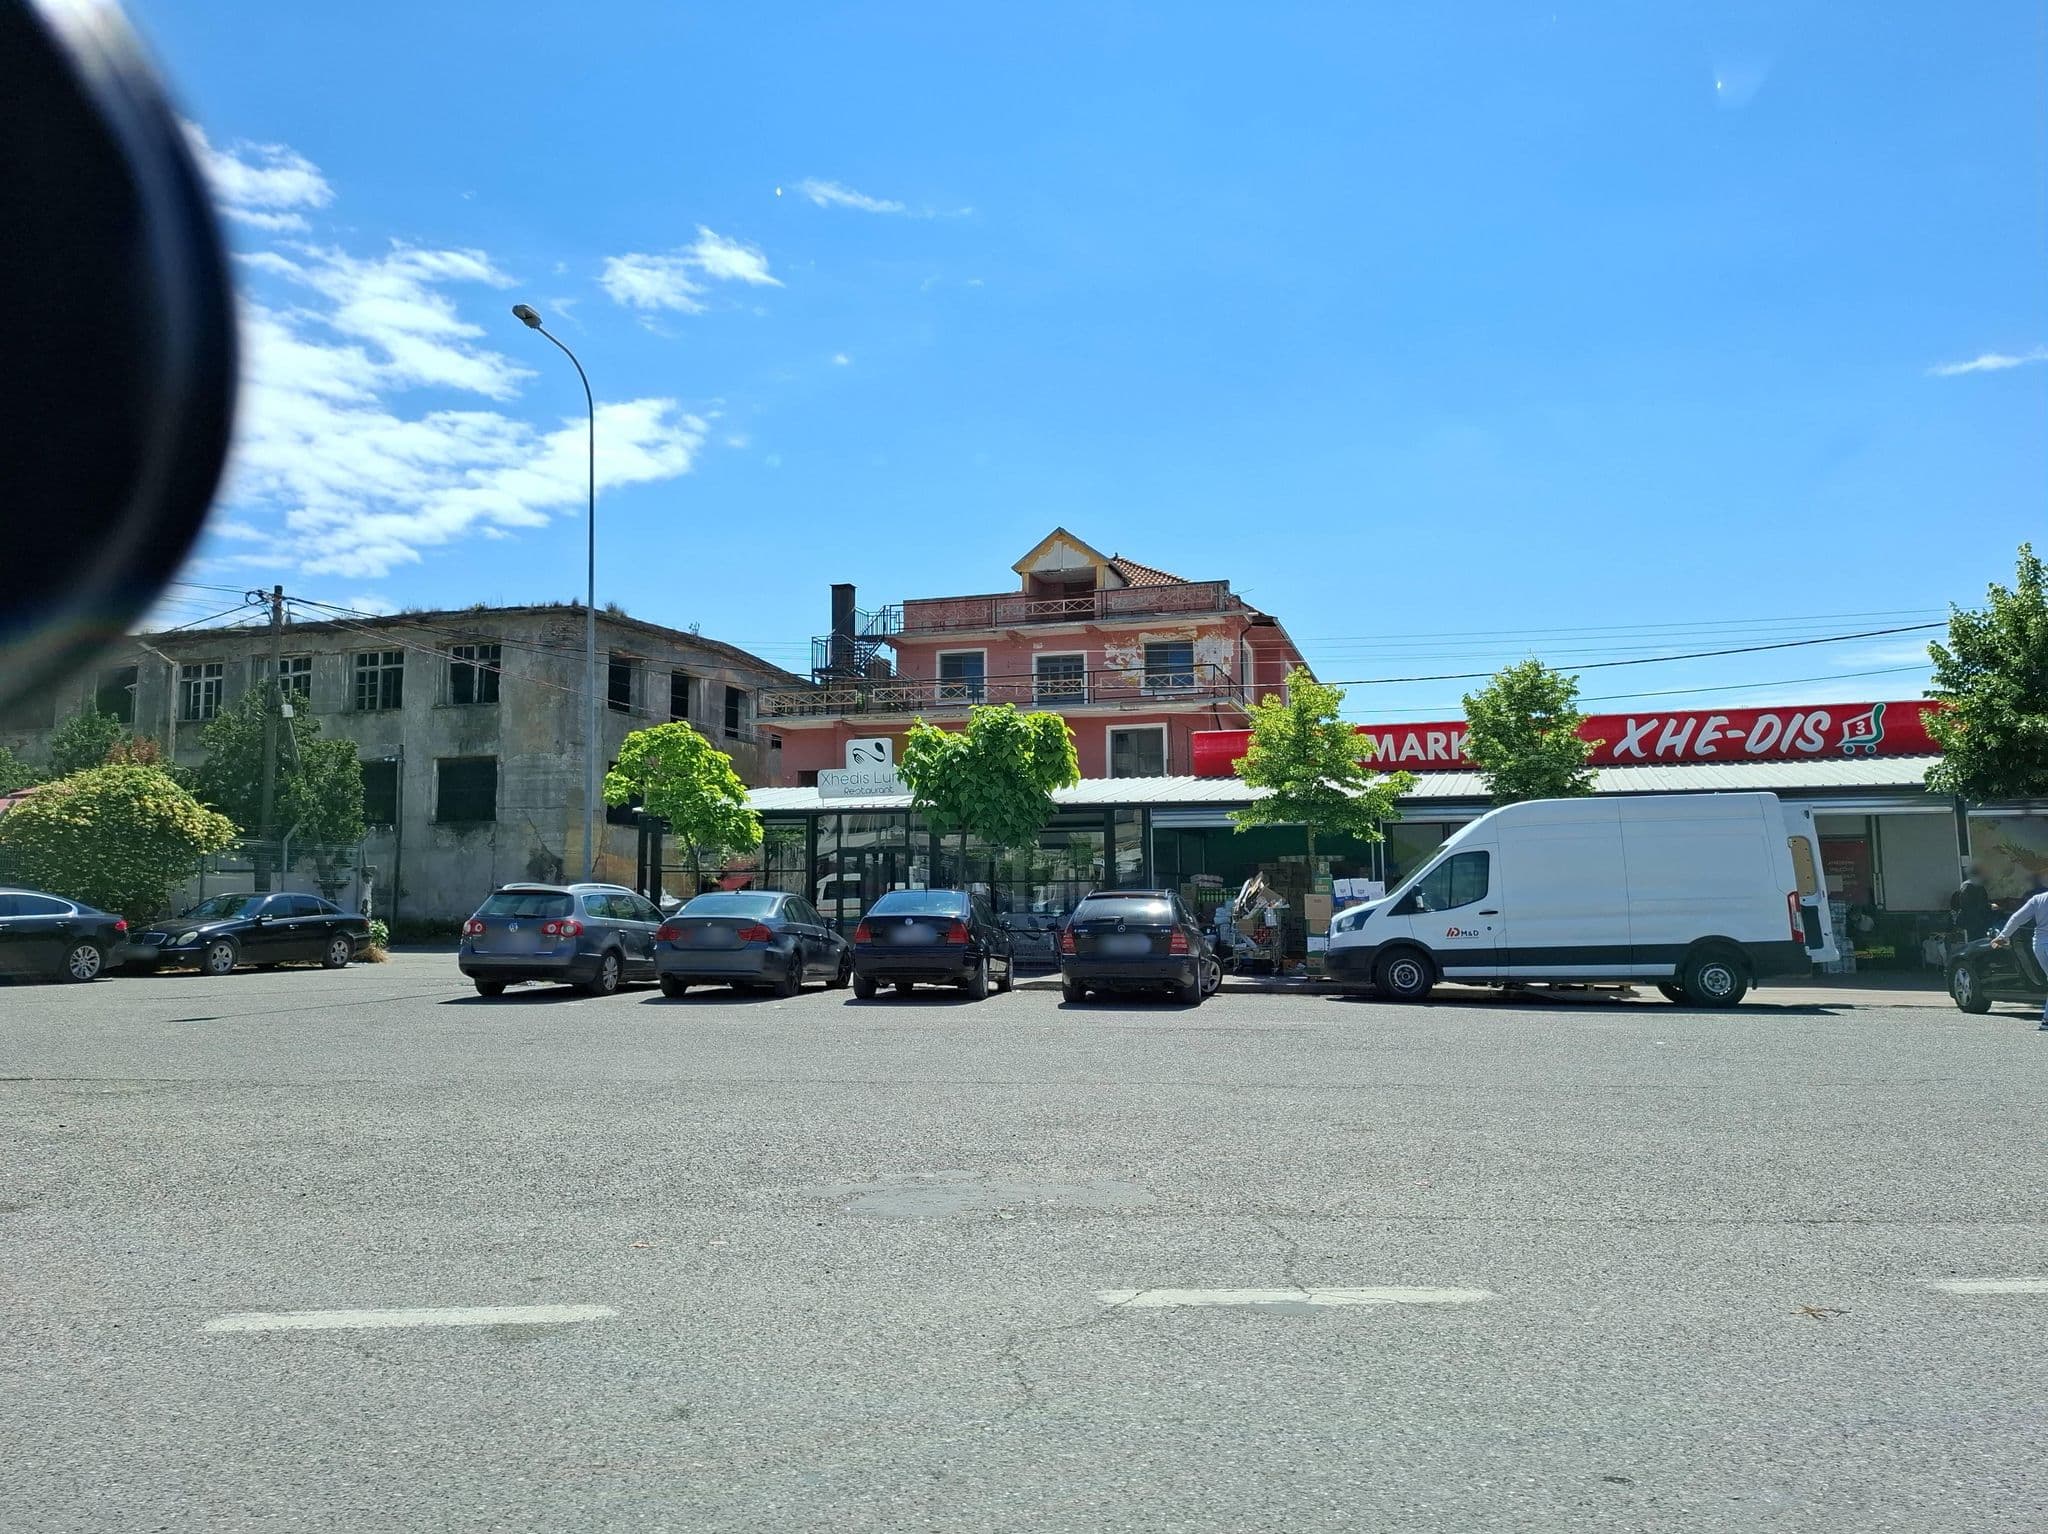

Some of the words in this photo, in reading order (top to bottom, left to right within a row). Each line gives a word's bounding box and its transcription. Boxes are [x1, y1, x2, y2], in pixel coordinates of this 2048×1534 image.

[1356, 731, 1471, 762] MARK
[1613, 711, 1831, 757] XHE-DIS
[1856, 721, 1865, 734] 3
[821, 771, 869, 785] Xhedis
[844, 786, 893, 795] Restaurant
